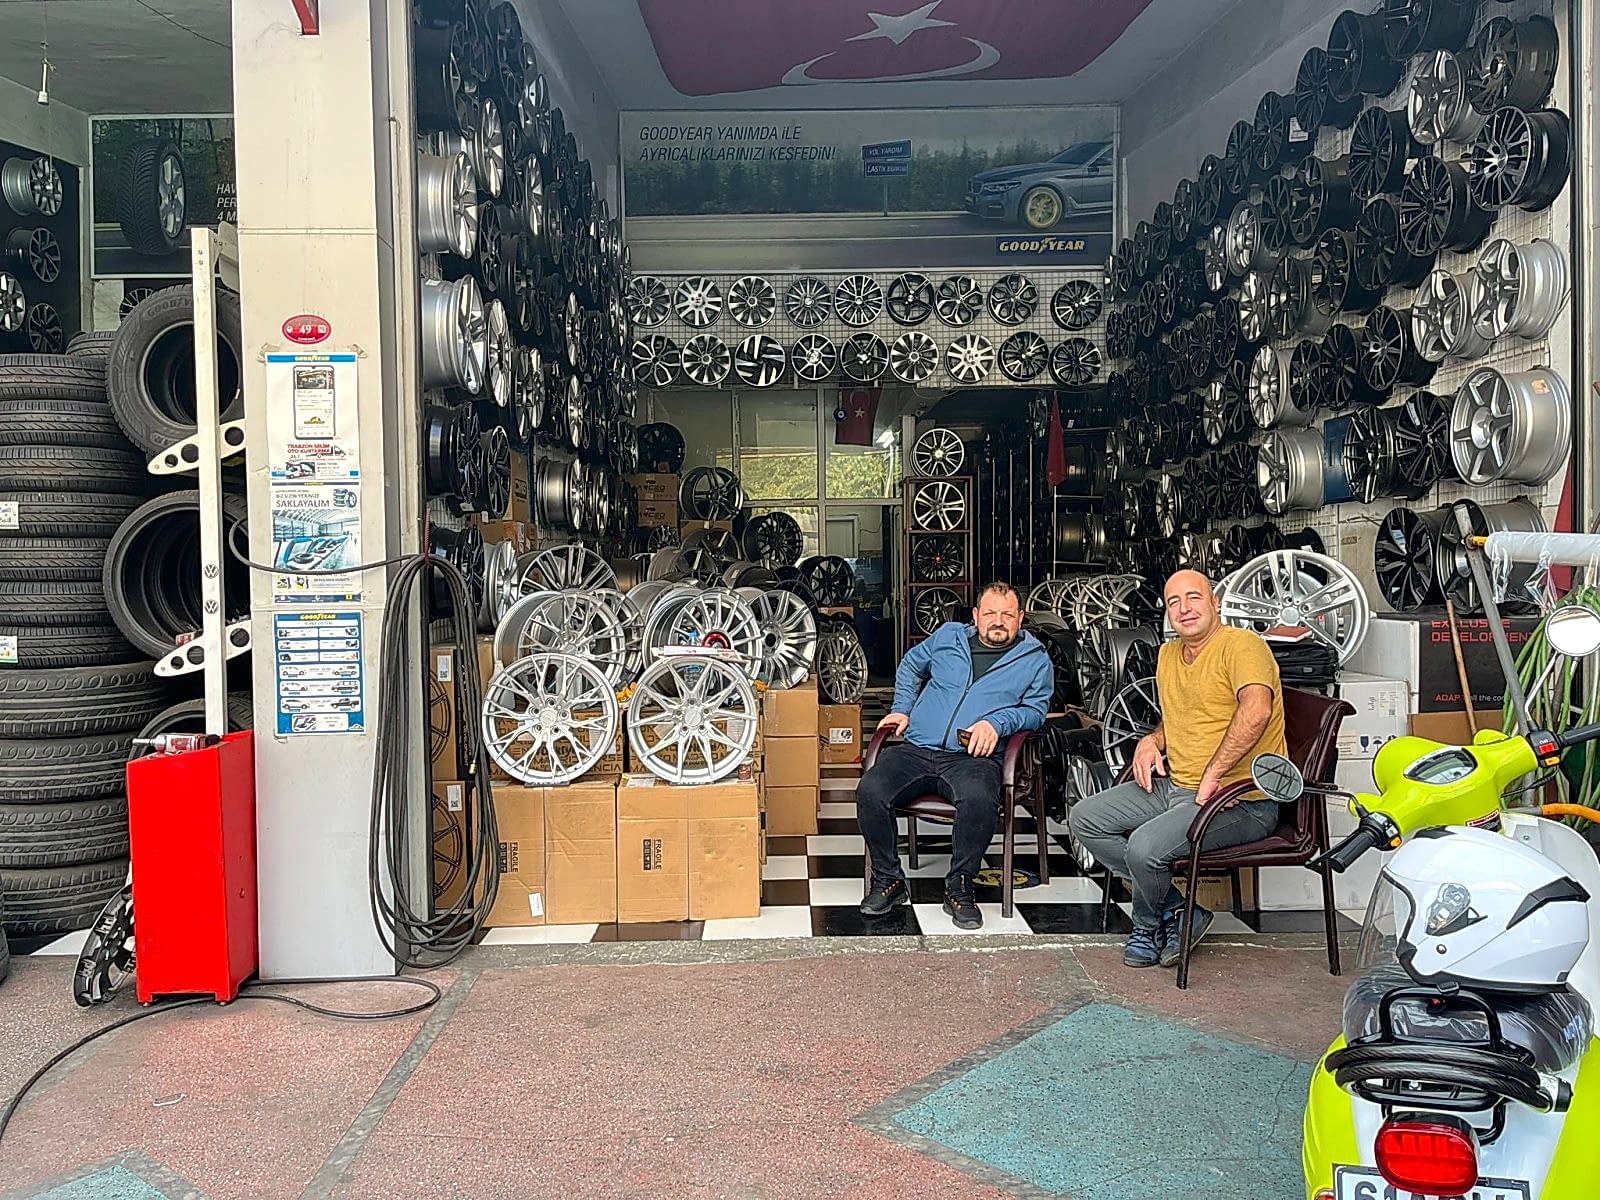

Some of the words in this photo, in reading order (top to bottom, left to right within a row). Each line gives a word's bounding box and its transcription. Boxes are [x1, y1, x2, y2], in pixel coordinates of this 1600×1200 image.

[640, 126, 713, 141] GOODYEAR
[717, 126, 778, 140] YANIMDA
[216, 197, 237, 208] PER
[226, 210, 237, 222] M
[1000, 238, 1085, 253] GOODYEAR
[276, 499, 330, 508] SAKLAYALIM
[1478, 694, 1491, 702] the
[511, 841, 519, 873] FRAGILE
